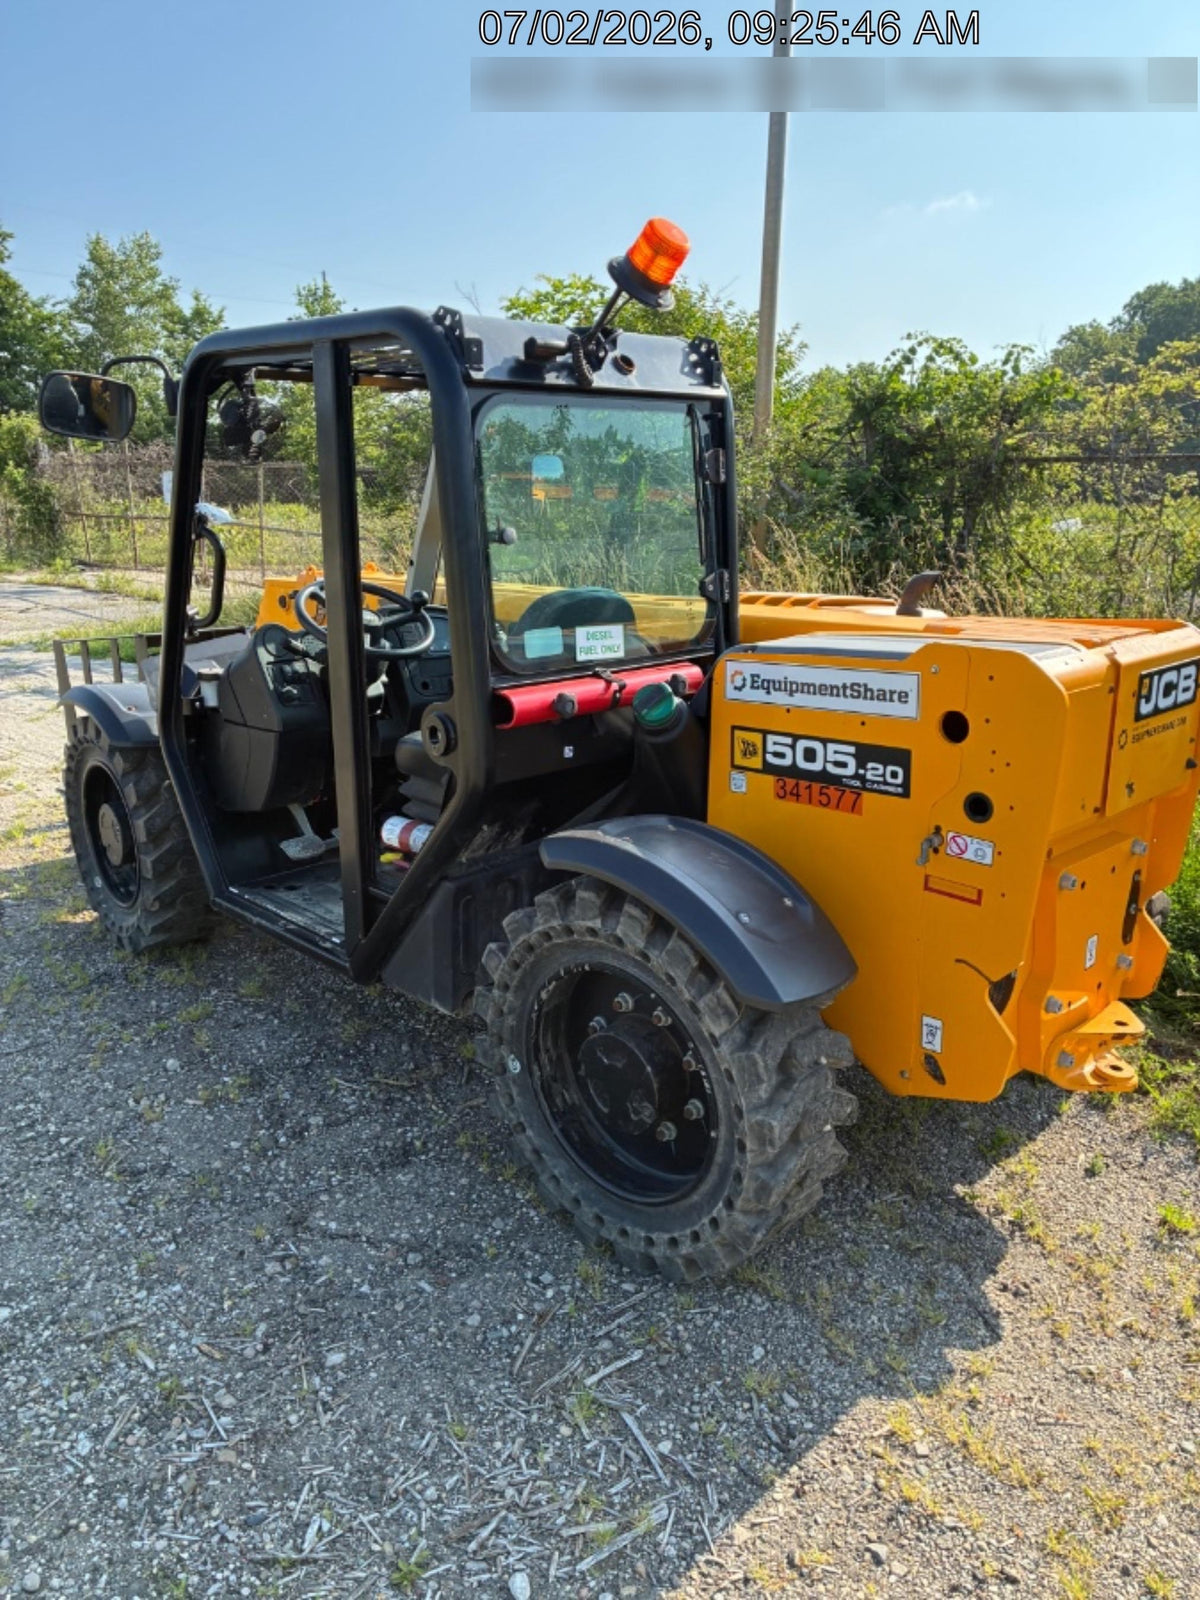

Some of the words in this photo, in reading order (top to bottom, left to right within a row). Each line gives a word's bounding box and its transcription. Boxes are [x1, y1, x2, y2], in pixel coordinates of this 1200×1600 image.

[579, 645, 599, 656] FUEL
[600, 643, 621, 654] ONLY
[586, 630, 614, 641] DIESEL
[750, 673, 910, 704] EquipmentShare
[1139, 664, 1197, 715] JCB
[776, 777, 862, 815] 341577
